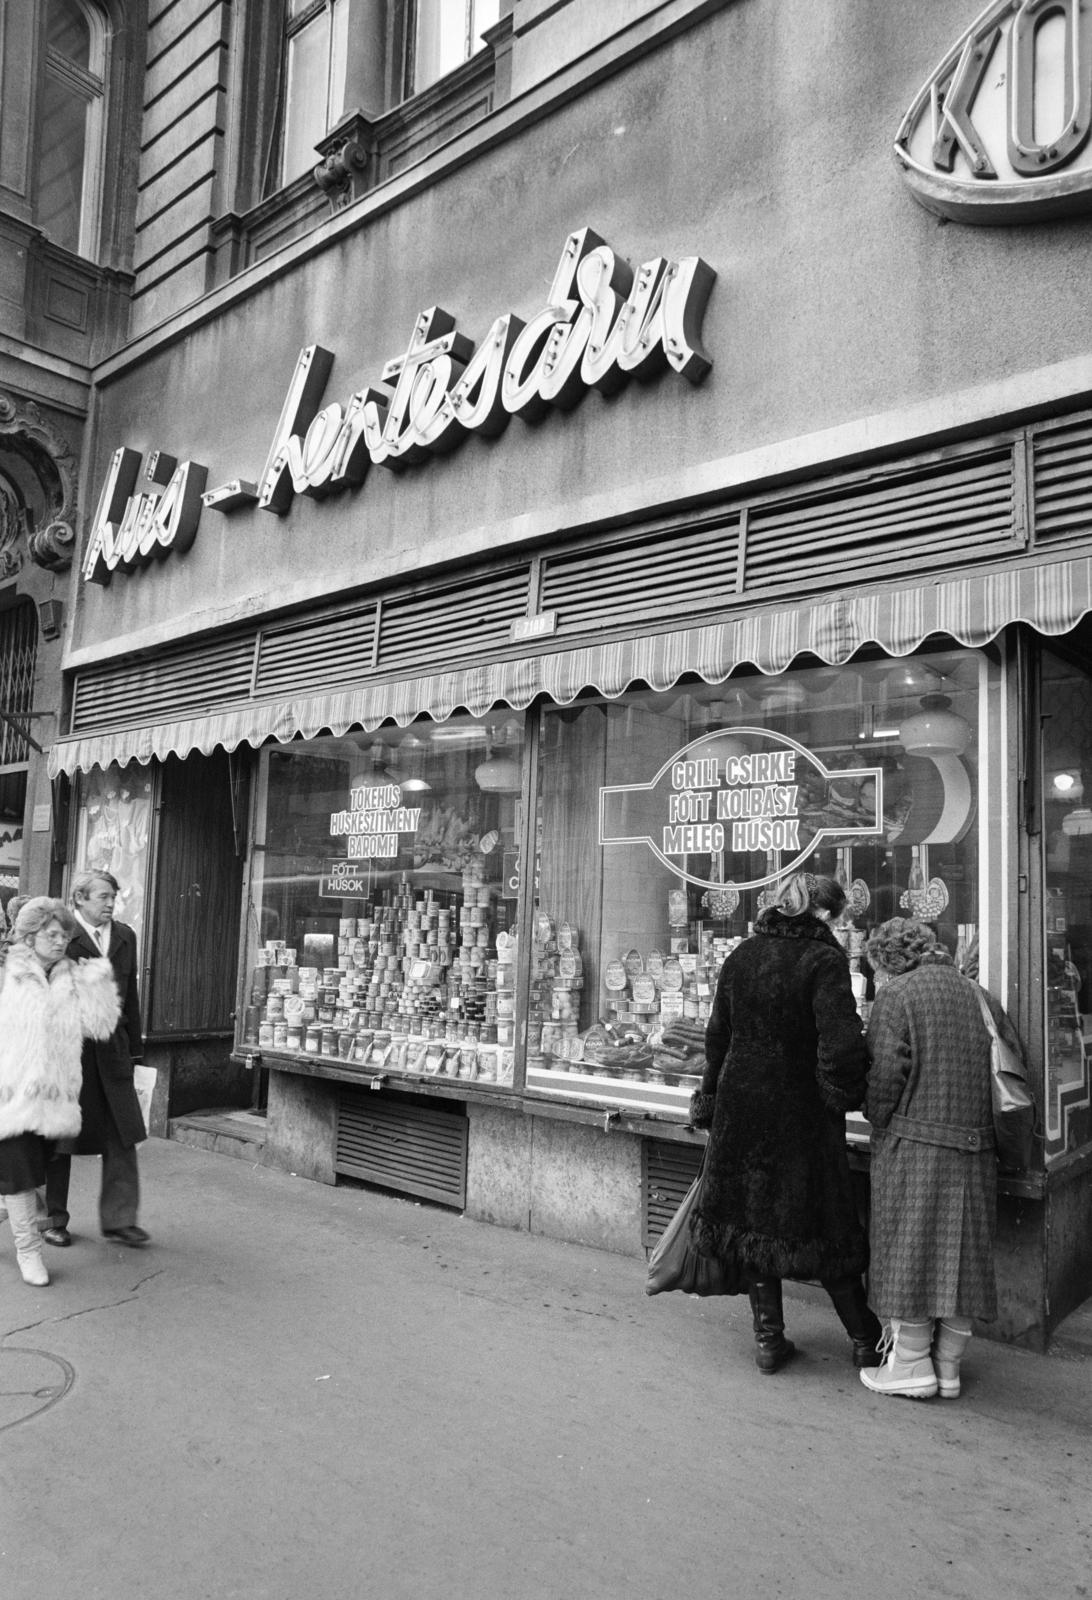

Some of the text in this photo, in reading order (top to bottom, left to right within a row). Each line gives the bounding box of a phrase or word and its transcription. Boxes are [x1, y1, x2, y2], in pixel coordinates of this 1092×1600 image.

[672, 749, 796, 790] GRILL CSIRKE
[717, 784, 799, 819] KOLBÁSZ
[348, 833, 399, 859] BAROMFI
[663, 818, 801, 854] MELEG HÚSOK
[327, 876, 364, 892] HÚSOK
